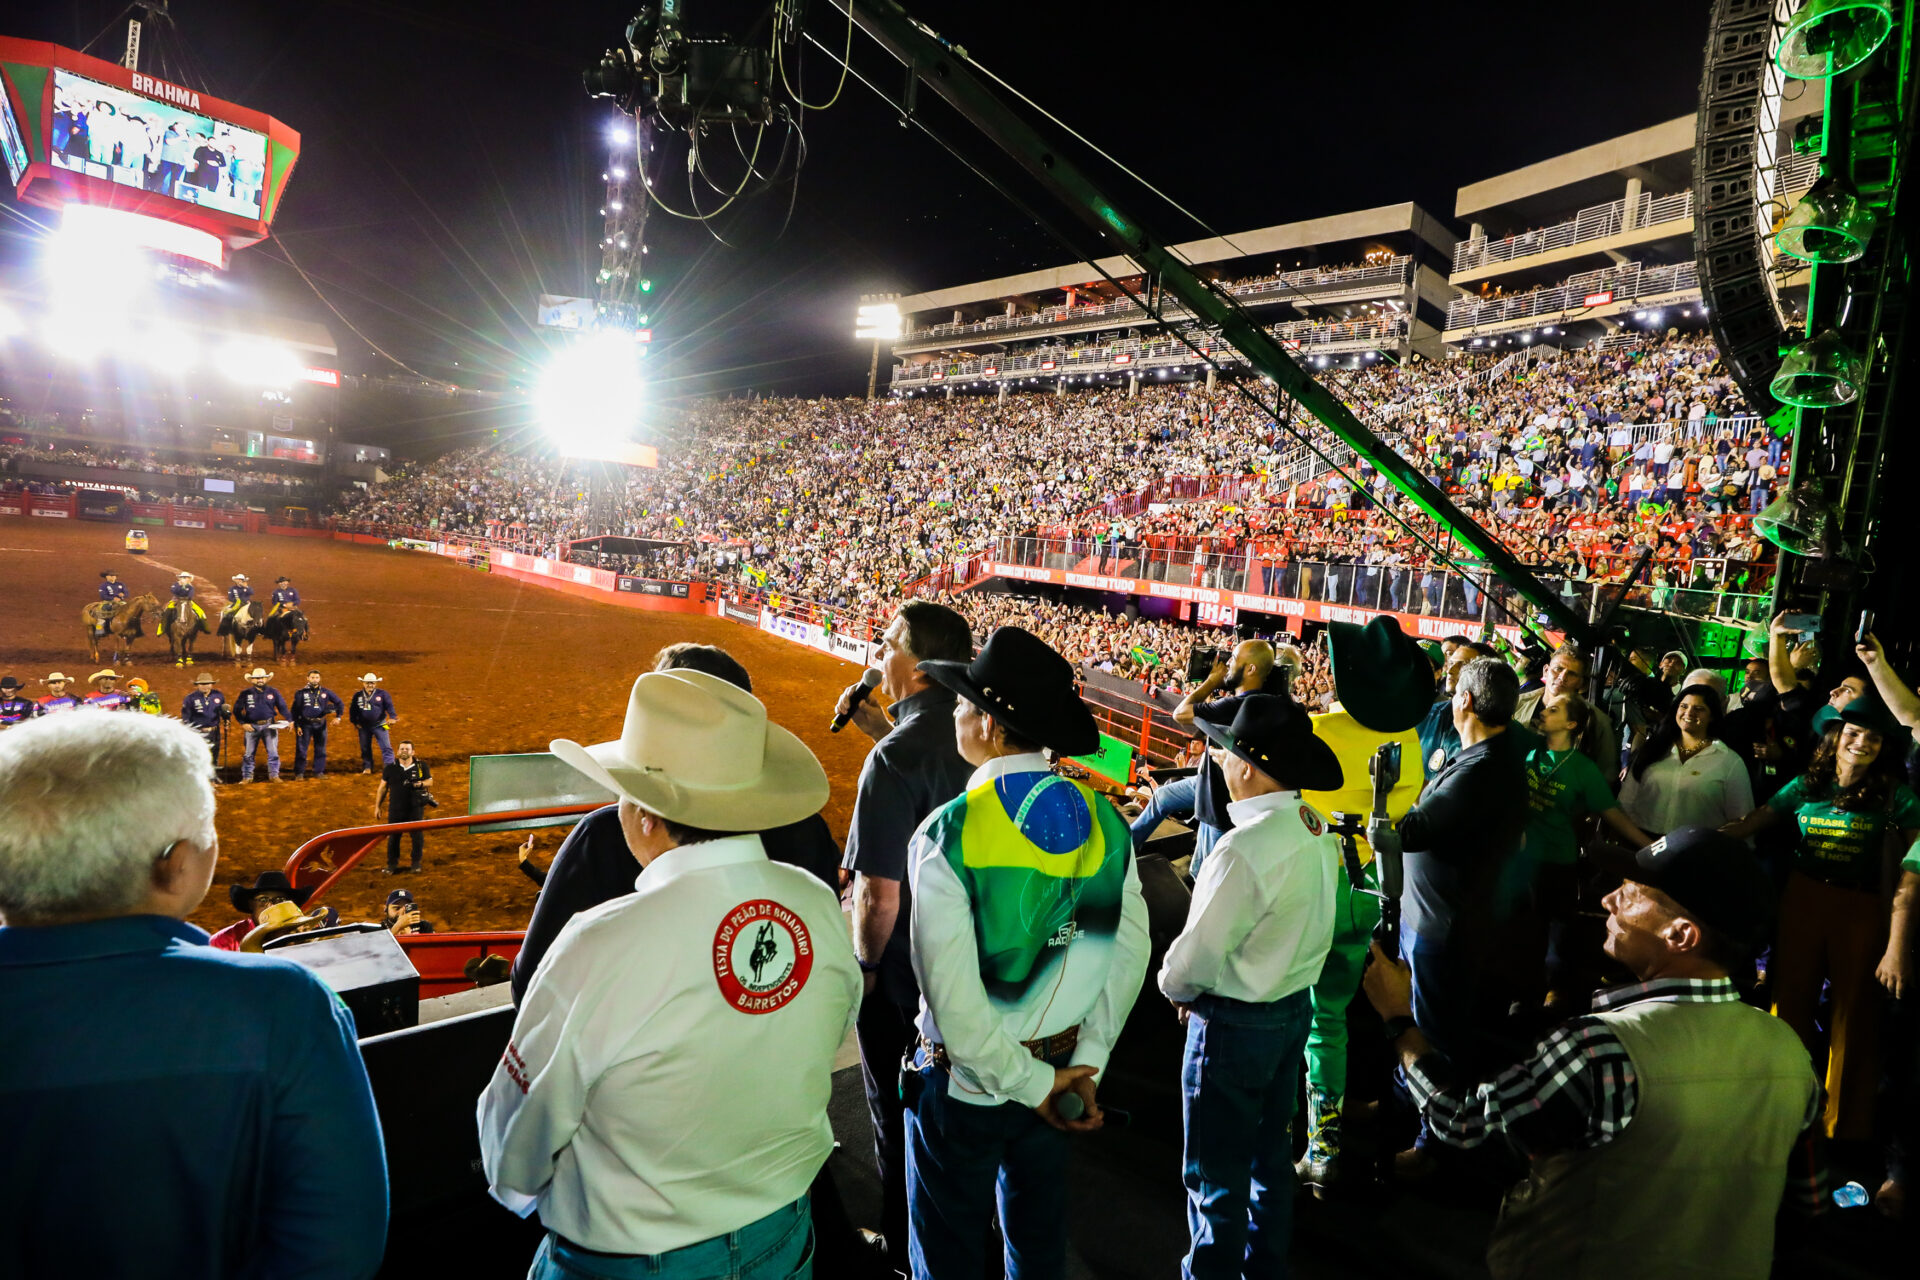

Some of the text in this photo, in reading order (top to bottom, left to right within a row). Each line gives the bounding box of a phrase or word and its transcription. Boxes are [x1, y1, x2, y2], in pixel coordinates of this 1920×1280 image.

[132, 72, 201, 110] BRAHMA
[1025, 568, 1051, 581] TUDO
[1108, 577, 1136, 593] TUDO
[1193, 588, 1220, 604] TUDO
[1278, 600, 1305, 617] TUDO
[1418, 618, 1466, 640] VOLTAMOS
[836, 637, 857, 652] RAM
[1800, 816, 1873, 831] O BRASIL QUE
[1807, 826, 1864, 840] QUEREMOS
[716, 904, 809, 978] FESTA DO PEÃO DE BOIADEIRO
[748, 962, 793, 992] INDEPENDENTES
[737, 978, 799, 1010] BARRETOS
